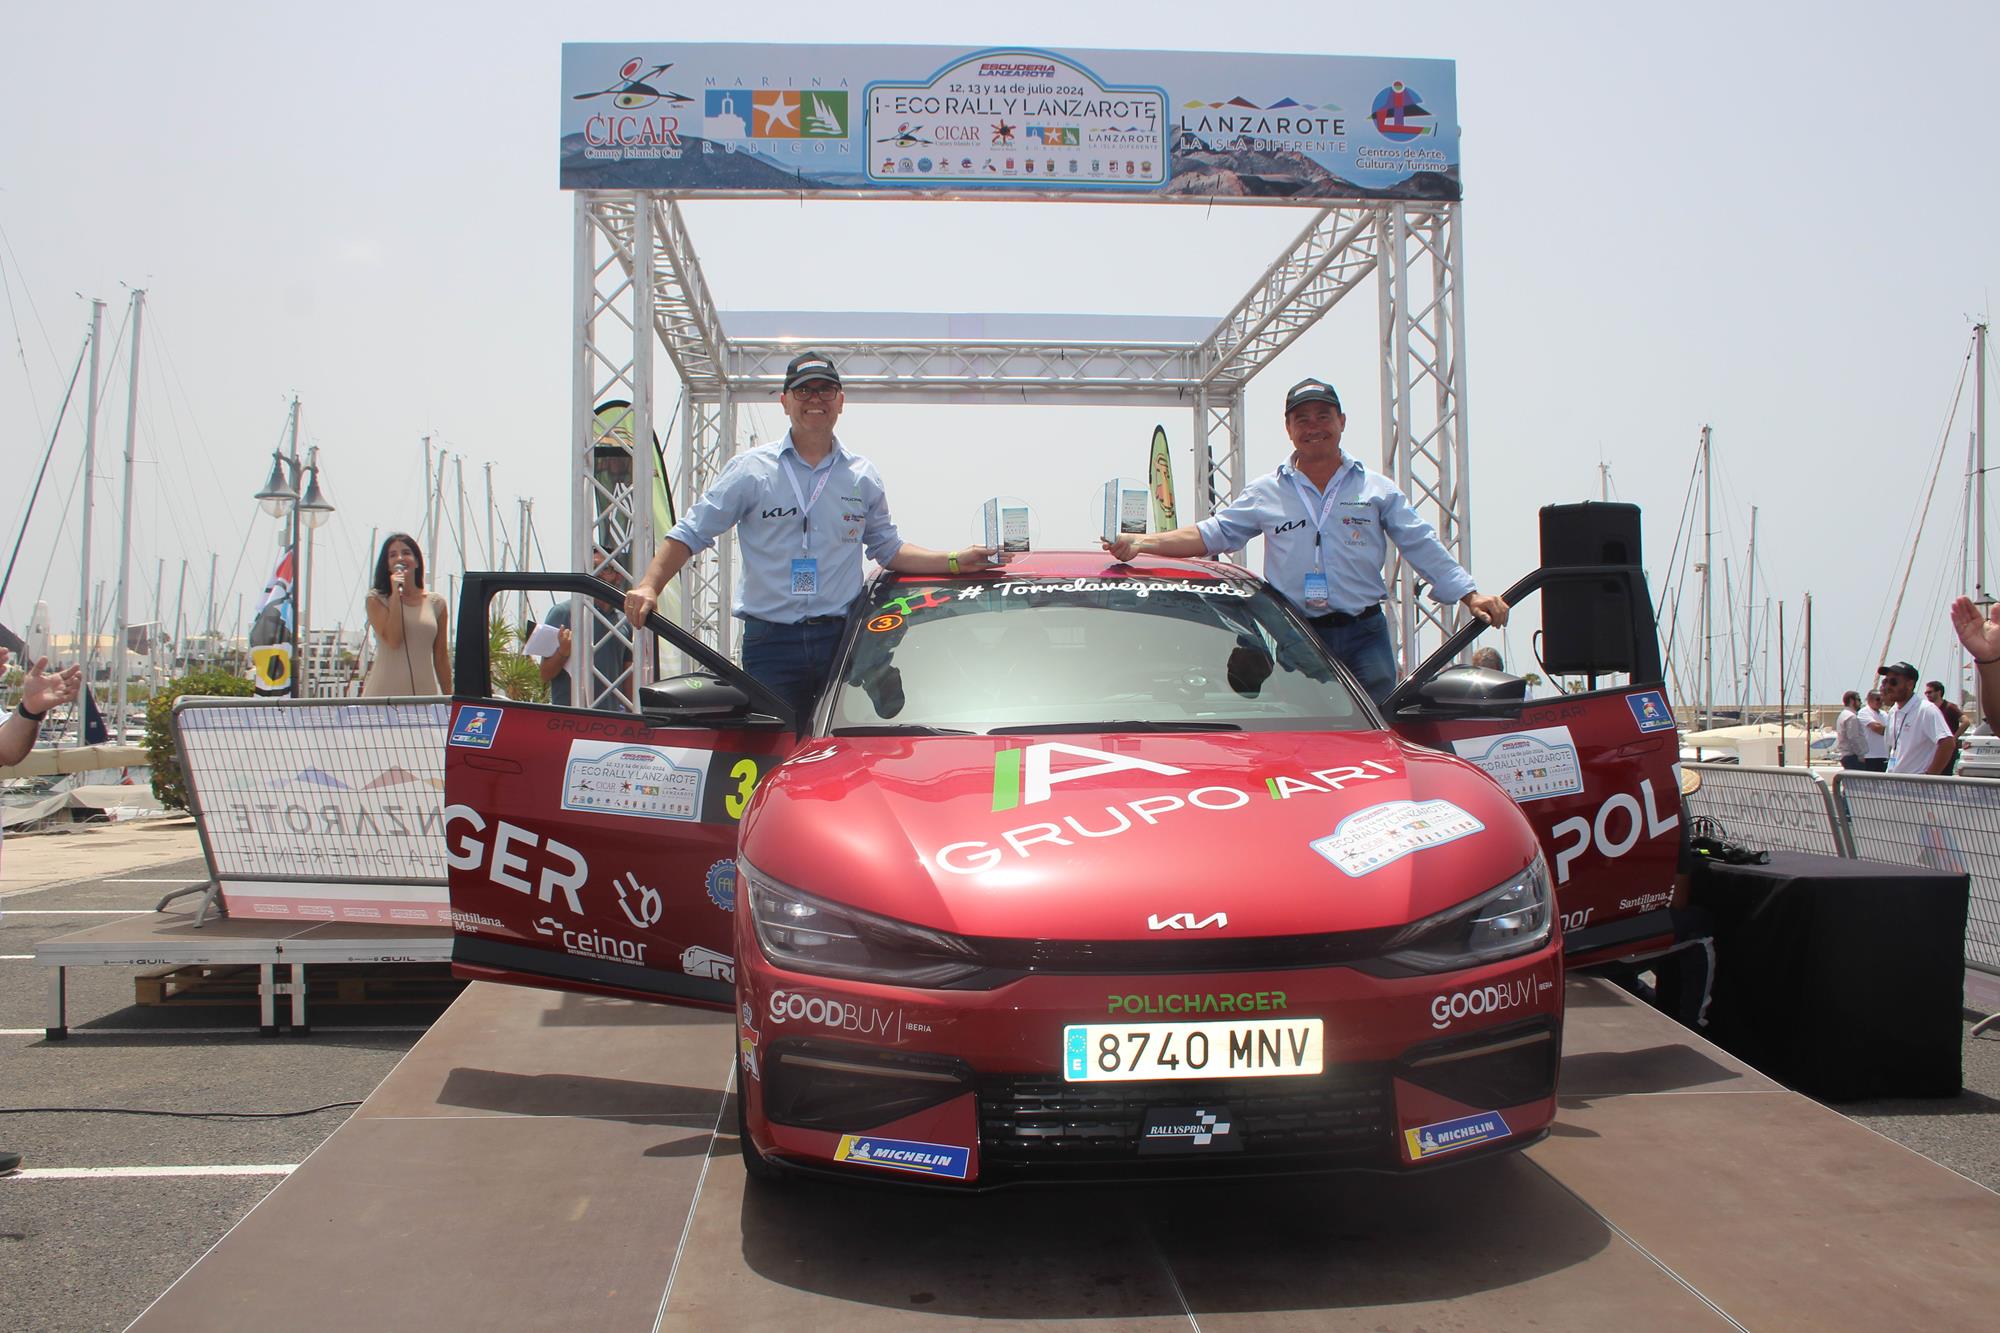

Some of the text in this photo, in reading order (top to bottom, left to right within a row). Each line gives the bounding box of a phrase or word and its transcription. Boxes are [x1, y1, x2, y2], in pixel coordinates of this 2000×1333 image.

[978, 70, 1056, 78] LANZAROTE
[980, 63, 1056, 72] ESCUDERIA
[704, 76, 849, 87] MARINA
[950, 84, 1084, 96] 12, 13 y 14 de julio 2024
[946, 98, 1017, 116] RALLY
[1023, 99, 1157, 119] LANZAROTE
[584, 115, 681, 147] CICAR
[935, 126, 980, 140] CICAR
[1180, 115, 1346, 136] LANZAROTE
[1088, 134, 1159, 143] LANZAROTE
[1180, 137, 1347, 153] LA ISLA DIFERENTE
[584, 147, 682, 160] Canary Islands Car
[702, 142, 850, 153] RUBICON
[1358, 147, 1446, 161] Centros de Arte,
[1356, 158, 1448, 172] Cultura y Turismo
[762, 507, 798, 519] KIA
[1275, 519, 1306, 534] KIA
[877, 617, 893, 629] 3
[546, 717, 617, 738] GRUPO
[1523, 750, 1572, 766] LANZAROTE
[602, 767, 635, 779] RALLY
[635, 770, 697, 785] LANZAROTE
[725, 758, 758, 820] 3
[935, 786, 1251, 876] GRUPO
[1639, 903, 1658, 914] Mar
[454, 921, 478, 933] Mar
[1147, 912, 1229, 931] KIA
[563, 928, 648, 962] ceinor
[1108, 991, 1287, 1014] POLICHARGER
[1431, 977, 1532, 1030] GOODBUY
[769, 990, 932, 1036] GOODBUY IBERIA
[1072, 1027, 1310, 1073] E 8740 MNV
[1438, 1121, 1495, 1143] MICHELIN
[873, 1148, 953, 1167] MICHELIN
